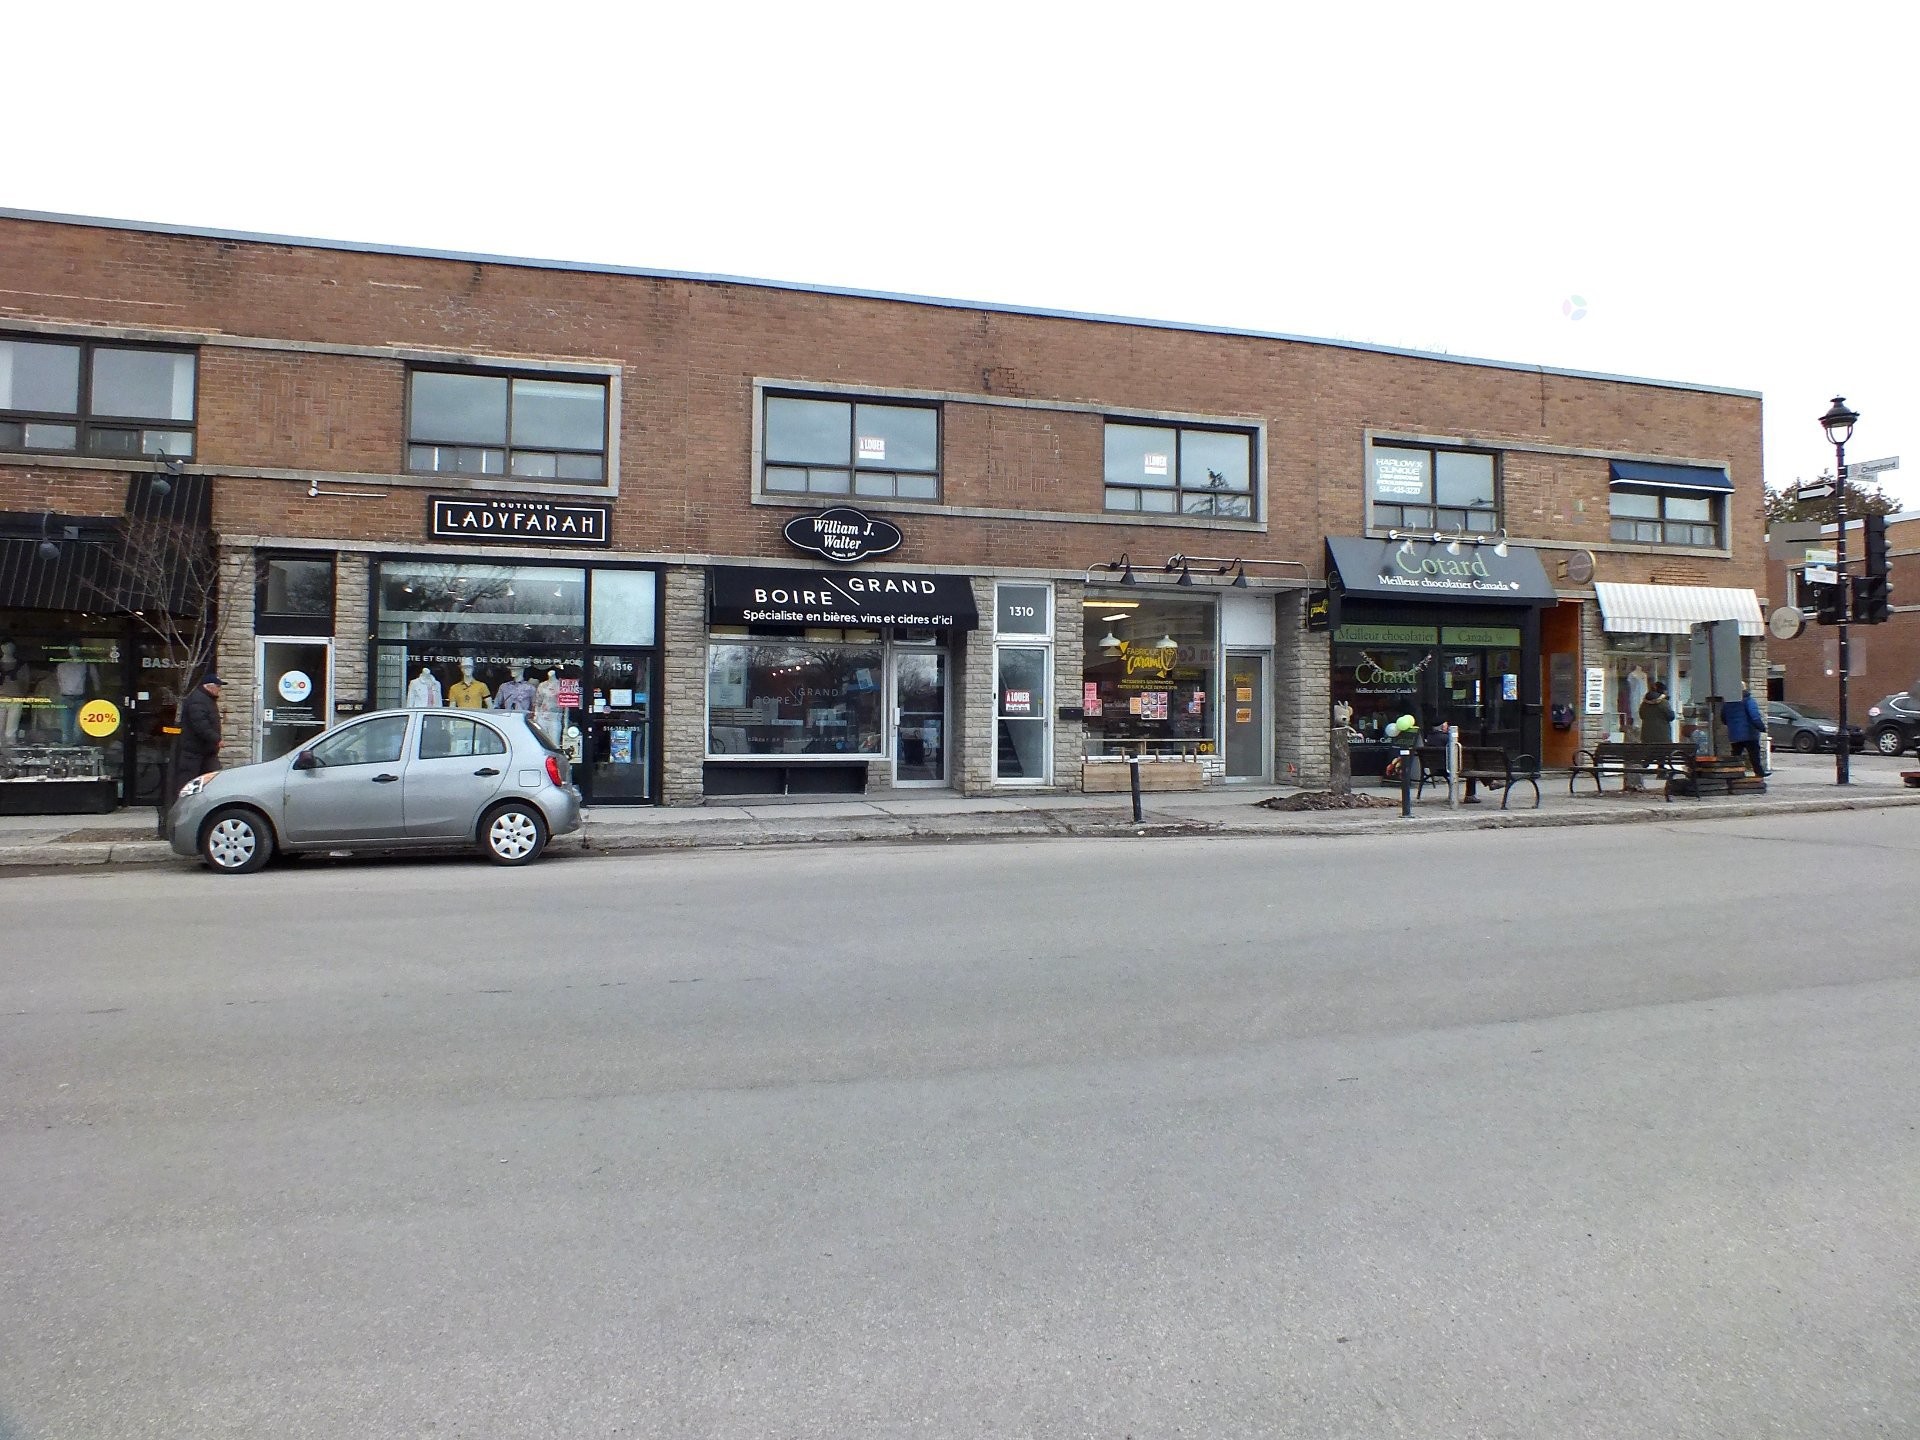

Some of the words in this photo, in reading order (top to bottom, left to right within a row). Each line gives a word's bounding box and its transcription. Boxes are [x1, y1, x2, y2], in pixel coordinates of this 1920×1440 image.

[865, 439, 885, 450] LOUER
[1380, 466, 1420, 475] CLINIQUE
[1861, 462, 1896, 473] Chambord
[493, 502, 550, 511] BOUTIQUE
[447, 510, 594, 533] LADYFARAH
[813, 519, 859, 535] William
[863, 522, 875, 536] J.
[824, 534, 862, 550] Walter
[1395, 549, 1490, 577] Cotard
[848, 577, 936, 594] GRAND
[1378, 575, 1419, 586] Meilleur
[1421, 577, 1472, 589] chocolatier
[1472, 580, 1510, 591] Canada
[754, 588, 833, 605] BOIRE
[743, 609, 803, 622] Spécialiste
[806, 614, 821, 622] en
[823, 611, 859, 623] bières,
[860, 613, 882, 624] vins
[883, 613, 896, 624] et
[897, 613, 930, 625] cidres
[931, 614, 953, 625] d'ici
[1009, 606, 1034, 617] 1310
[1338, 628, 1379, 641] Meilleur
[1381, 630, 1434, 642] chocolatier
[1457, 631, 1492, 643] Canada
[381, 654, 421, 662] STYLSTE
[611, 663, 633, 671] 1316
[1355, 663, 1417, 684] Cotard
[798, 687, 839, 697] GRAND
[1011, 692, 1030, 702] LOUER
[756, 695, 790, 704] BOIRE
[83, 713, 117, 723] -20%
